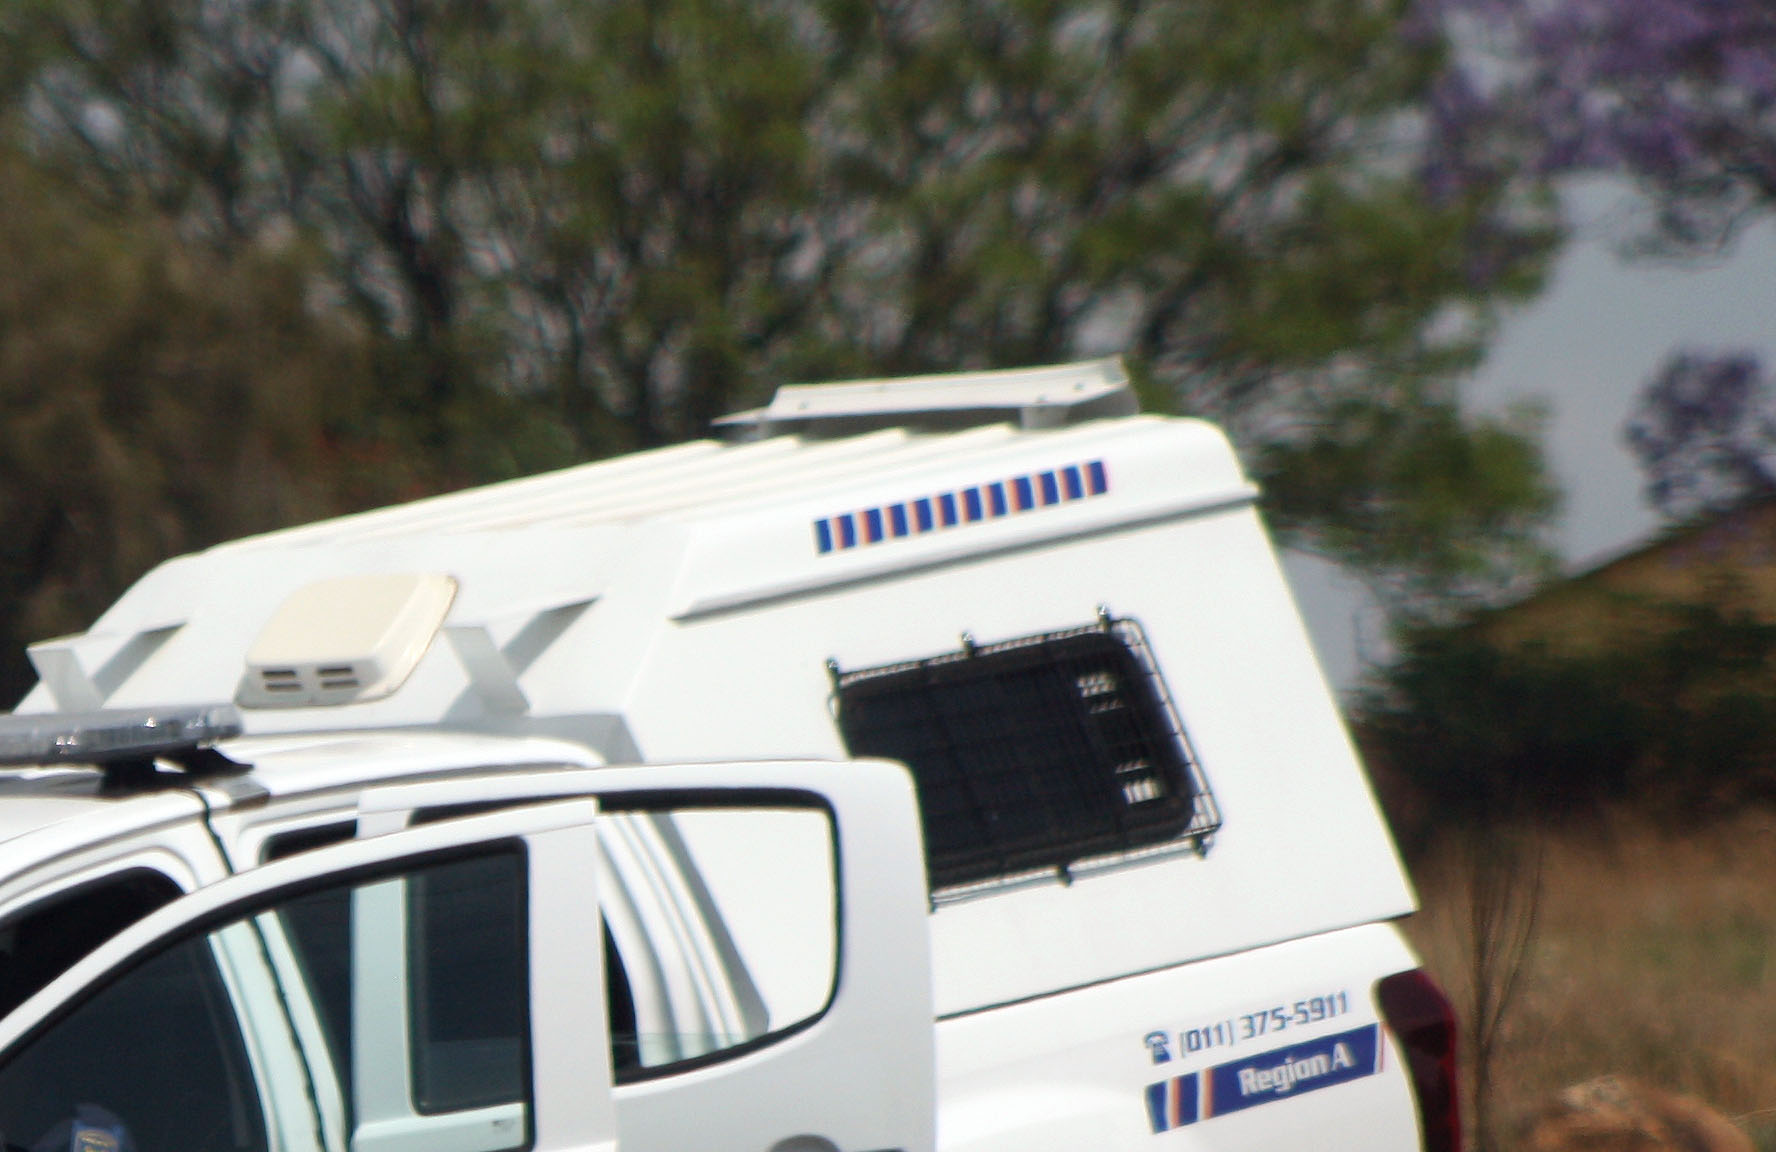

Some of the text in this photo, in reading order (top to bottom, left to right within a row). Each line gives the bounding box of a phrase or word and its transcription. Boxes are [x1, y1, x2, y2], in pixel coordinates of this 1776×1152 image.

[1179, 990, 1350, 1059] (011) 375-5911
[1237, 1042, 1355, 1097] Region A
